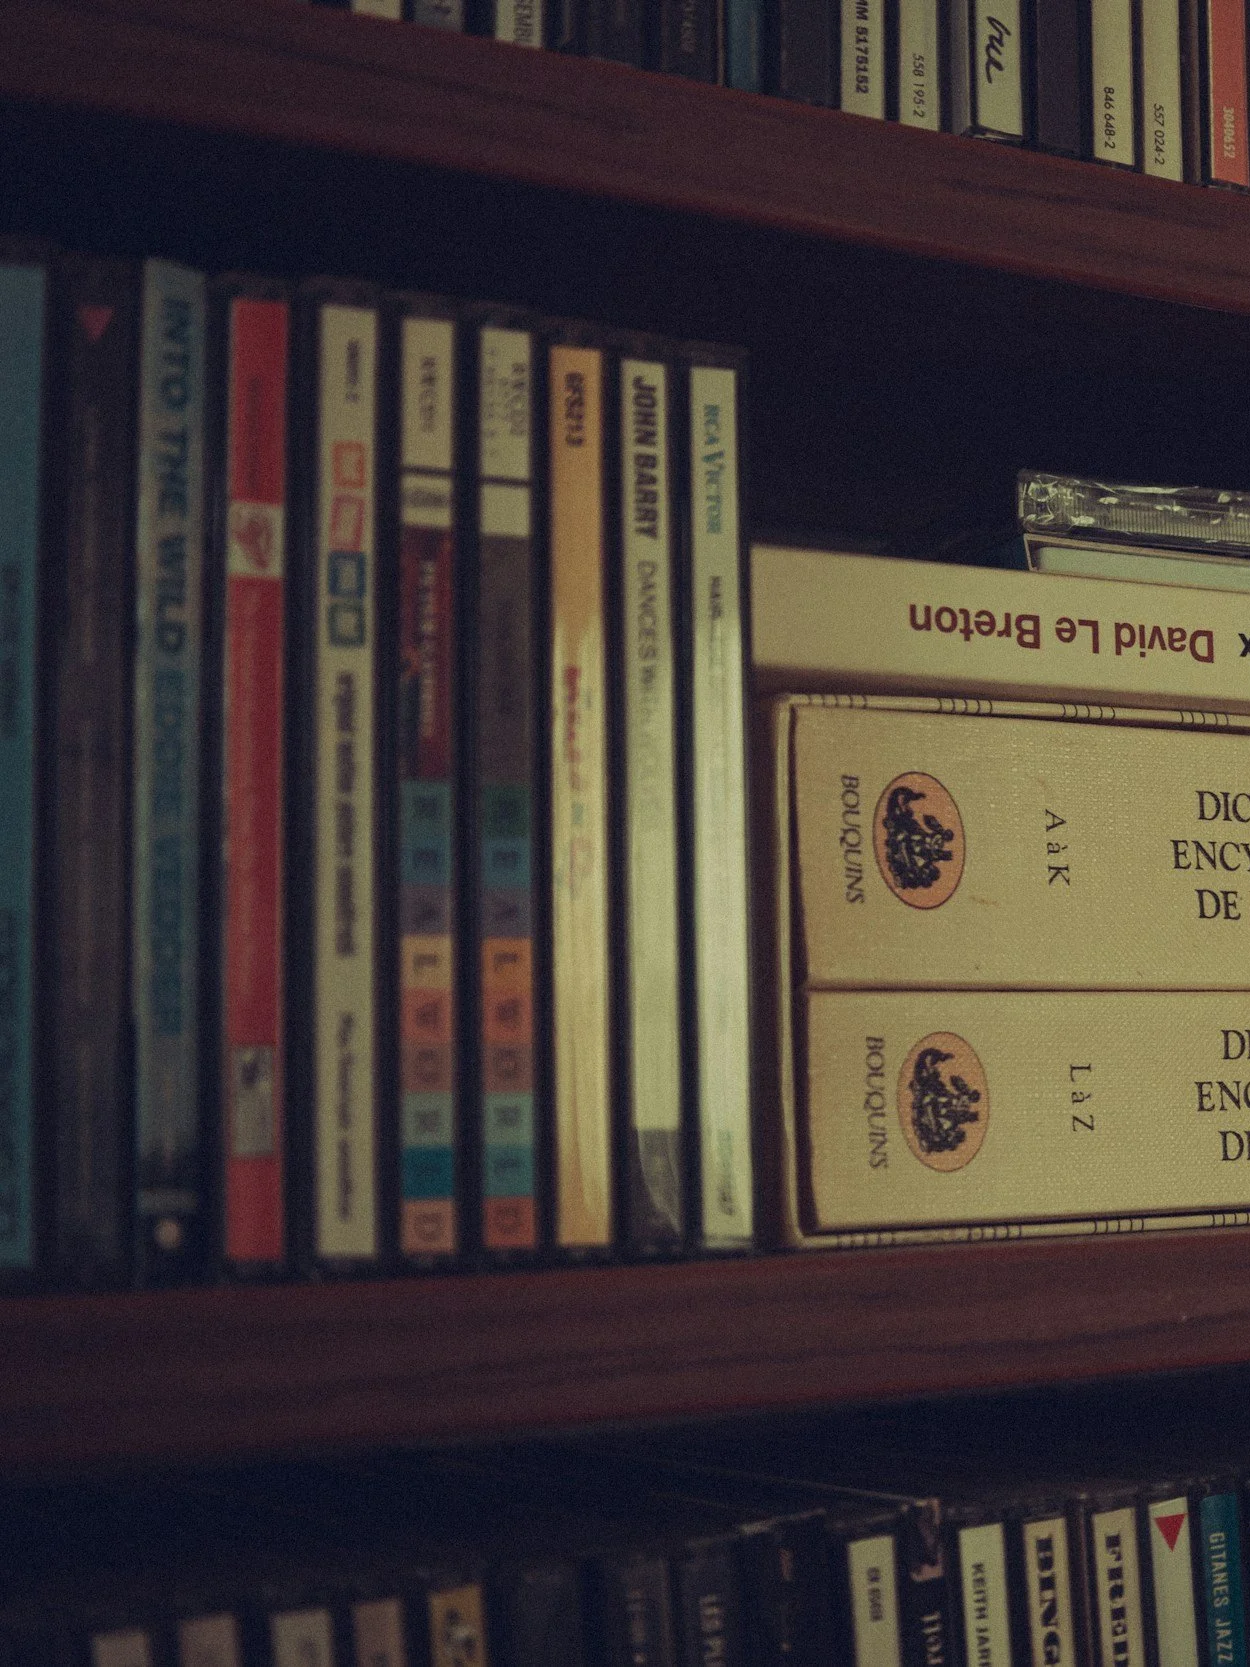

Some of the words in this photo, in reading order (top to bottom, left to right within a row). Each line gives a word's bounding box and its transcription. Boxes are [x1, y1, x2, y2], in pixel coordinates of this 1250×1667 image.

[855, 25, 869, 95] 5175152
[911, 53, 926, 77] 558
[912, 82, 927, 119] 195-2
[1104, 86, 1117, 110] 846
[1153, 103, 1166, 127] 557
[1104, 112, 1118, 150] 648-2
[1153, 129, 1167, 166] 024-2
[1222, 105, 1236, 159] 3040652
[159, 299, 193, 413] INTO
[633, 376, 658, 447] JOHN
[702, 404, 724, 447] RCA
[157, 425, 190, 519] THE
[702, 450, 727, 536] VICTOR
[635, 452, 660, 540] BARRY
[156, 534, 188, 655] WILD
[637, 560, 660, 660] DANCES
[908, 603, 1041, 650] Breton
[1055, 616, 1101, 655] Le
[1114, 622, 1216, 664] David
[839, 774, 866, 905] BOUQUINS
[1045, 809, 1068, 833] A
[1046, 841, 1069, 856] à
[1047, 863, 1071, 887] K
[1194, 888, 1243, 921] DE
[1069, 1062, 1093, 1084] L
[863, 1035, 889, 1170] BOUQUINS
[1070, 1089, 1093, 1106] à
[1071, 1113, 1096, 1133] Z
[972, 1562, 990, 1620] KEITH
[1208, 1530, 1232, 1608] GITANES
[1033, 1534, 1061, 1665] BING
[1214, 1617, 1235, 1664] JAZZ
